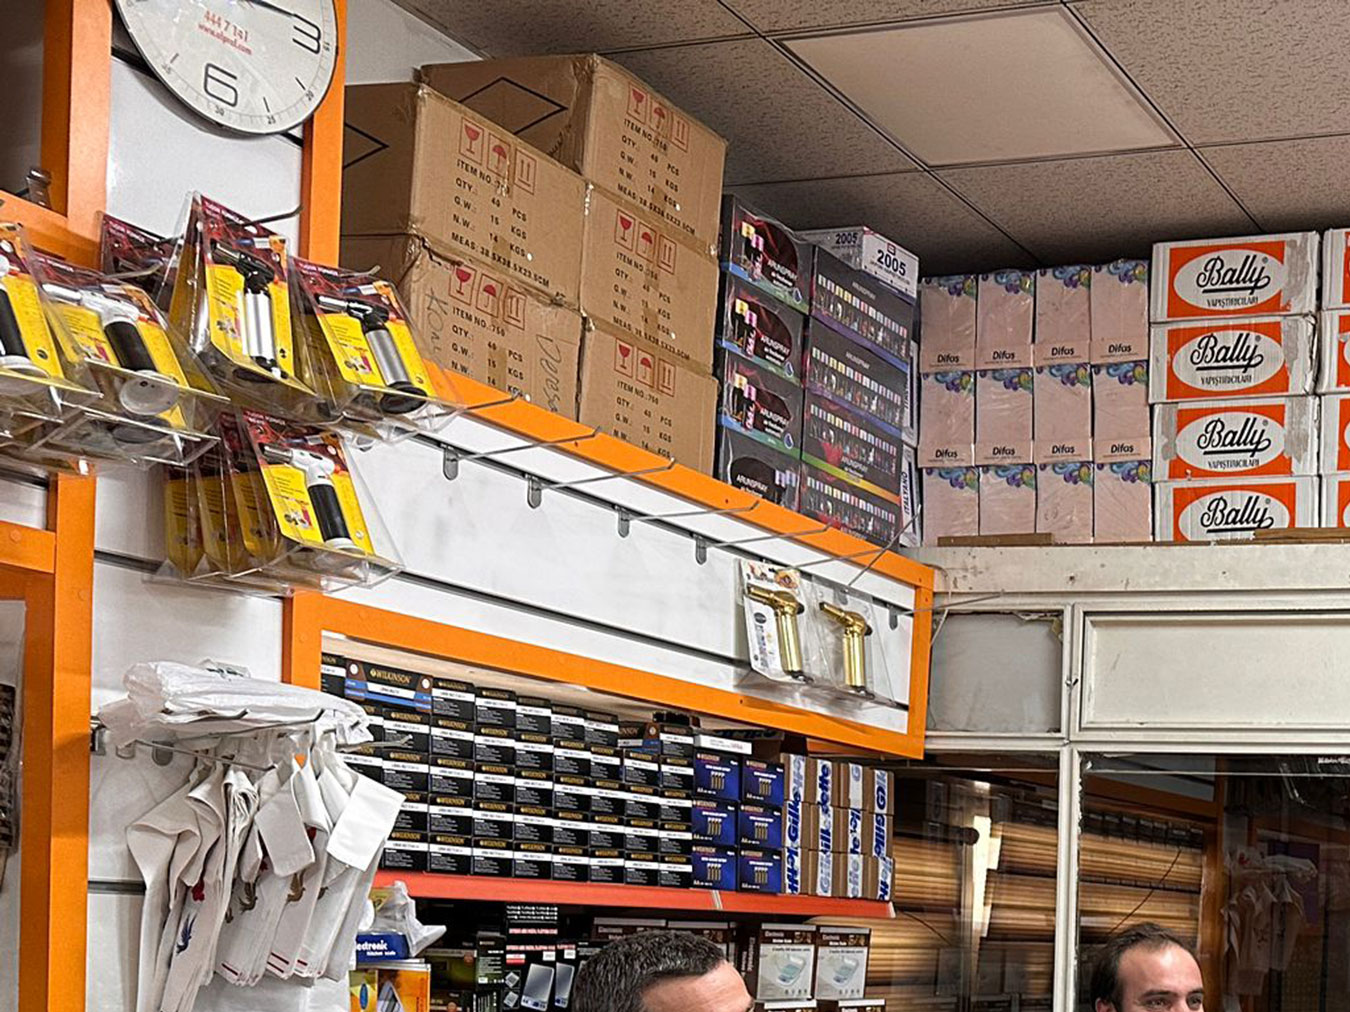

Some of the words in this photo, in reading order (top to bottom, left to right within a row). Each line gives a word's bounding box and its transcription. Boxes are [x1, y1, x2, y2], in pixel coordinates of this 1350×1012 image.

[292, 14, 321, 54] 3
[204, 63, 238, 107] 6
[456, 158, 478, 179] ITEM
[510, 225, 527, 240] KGS
[835, 231, 859, 246] 2005
[509, 243, 526, 258] KGS
[875, 248, 908, 278] 2005
[1196, 255, 1271, 295] Bally
[452, 306, 474, 324] ITEM
[1190, 332, 1264, 374] Bally
[507, 367, 524, 380] KGS
[1196, 417, 1272, 458] Bally
[1200, 495, 1275, 532] Bally
